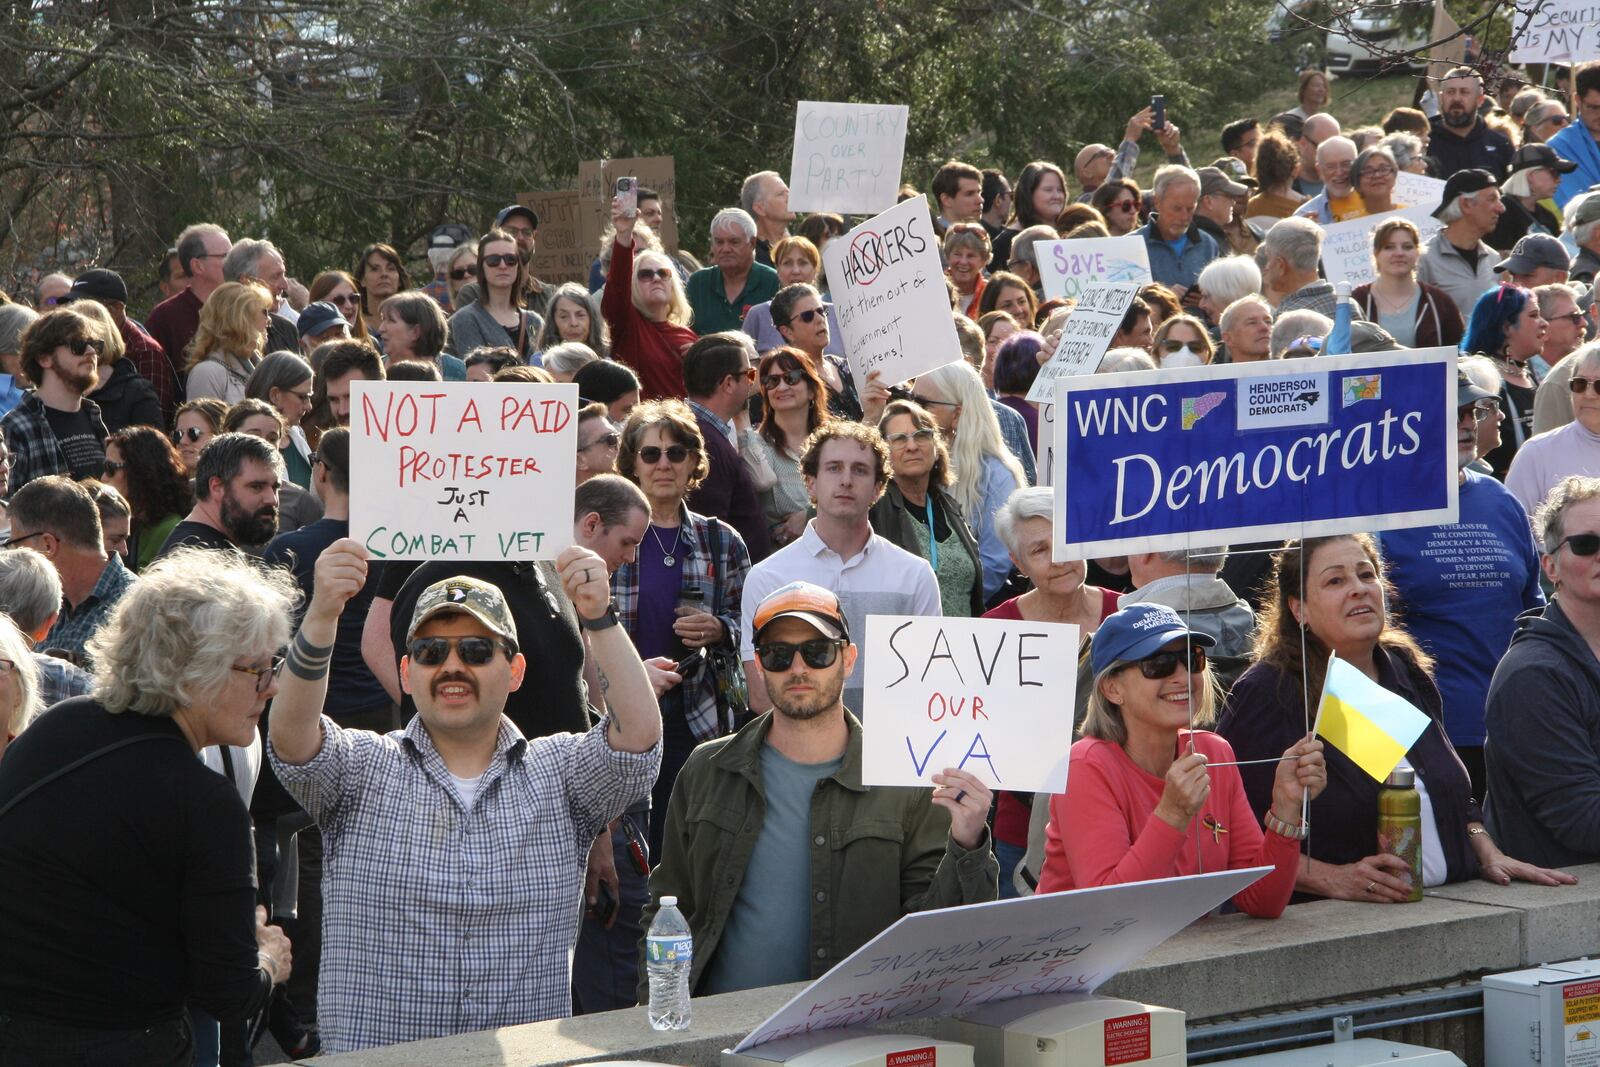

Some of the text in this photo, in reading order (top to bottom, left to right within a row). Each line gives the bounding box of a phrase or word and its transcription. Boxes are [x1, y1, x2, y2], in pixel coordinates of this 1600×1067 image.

[1534, 3, 1600, 28] Securi
[1525, 30, 1540, 48] is
[1544, 26, 1584, 55] MY
[802, 110, 899, 141] COUNTRY
[832, 142, 865, 158] OVER
[806, 153, 884, 195] PARTY
[841, 217, 926, 289] HACKERS
[1336, 241, 1369, 255] VALOR
[1344, 268, 1372, 280] PAR
[857, 291, 884, 314] them
[887, 281, 908, 300] out
[913, 270, 926, 289] of
[851, 316, 901, 354] Government
[1077, 320, 1113, 338] DEFUNDING
[859, 334, 904, 376] Systems!
[1057, 341, 1094, 366] RESEARCH
[1250, 379, 1316, 394] HENDERSON
[1250, 392, 1295, 405] COUNTY
[363, 391, 570, 442] NOT A PAID
[1075, 393, 1168, 437] WNC
[1250, 403, 1307, 416] DEMOCRATS
[399, 445, 541, 488] PROTESTER
[1109, 409, 1422, 525] Democrats
[437, 487, 490, 506] JUST
[453, 508, 469, 523] A
[366, 526, 545, 558] COMBAT VET
[1420, 548, 1457, 557] FREEDOM
[1465, 547, 1493, 555] VOTING
[1427, 540, 1473, 548] DEMOCRACY
[1449, 580, 1503, 588] INSURRECTION
[1457, 572, 1478, 580] FEAR,
[1480, 571, 1498, 579] HATE
[885, 621, 1048, 688] SAVE
[928, 692, 989, 721] OUR
[1023, 926, 1081, 947] OF
[854, 936, 1011, 978] UKRAINE
[900, 943, 1092, 985] FASTER THAN
[968, 967, 1018, 985] OF
[808, 975, 964, 1016] AMERICA
[1112, 1018, 1142, 1030] WARNING
[896, 1051, 927, 1064] WARNING
